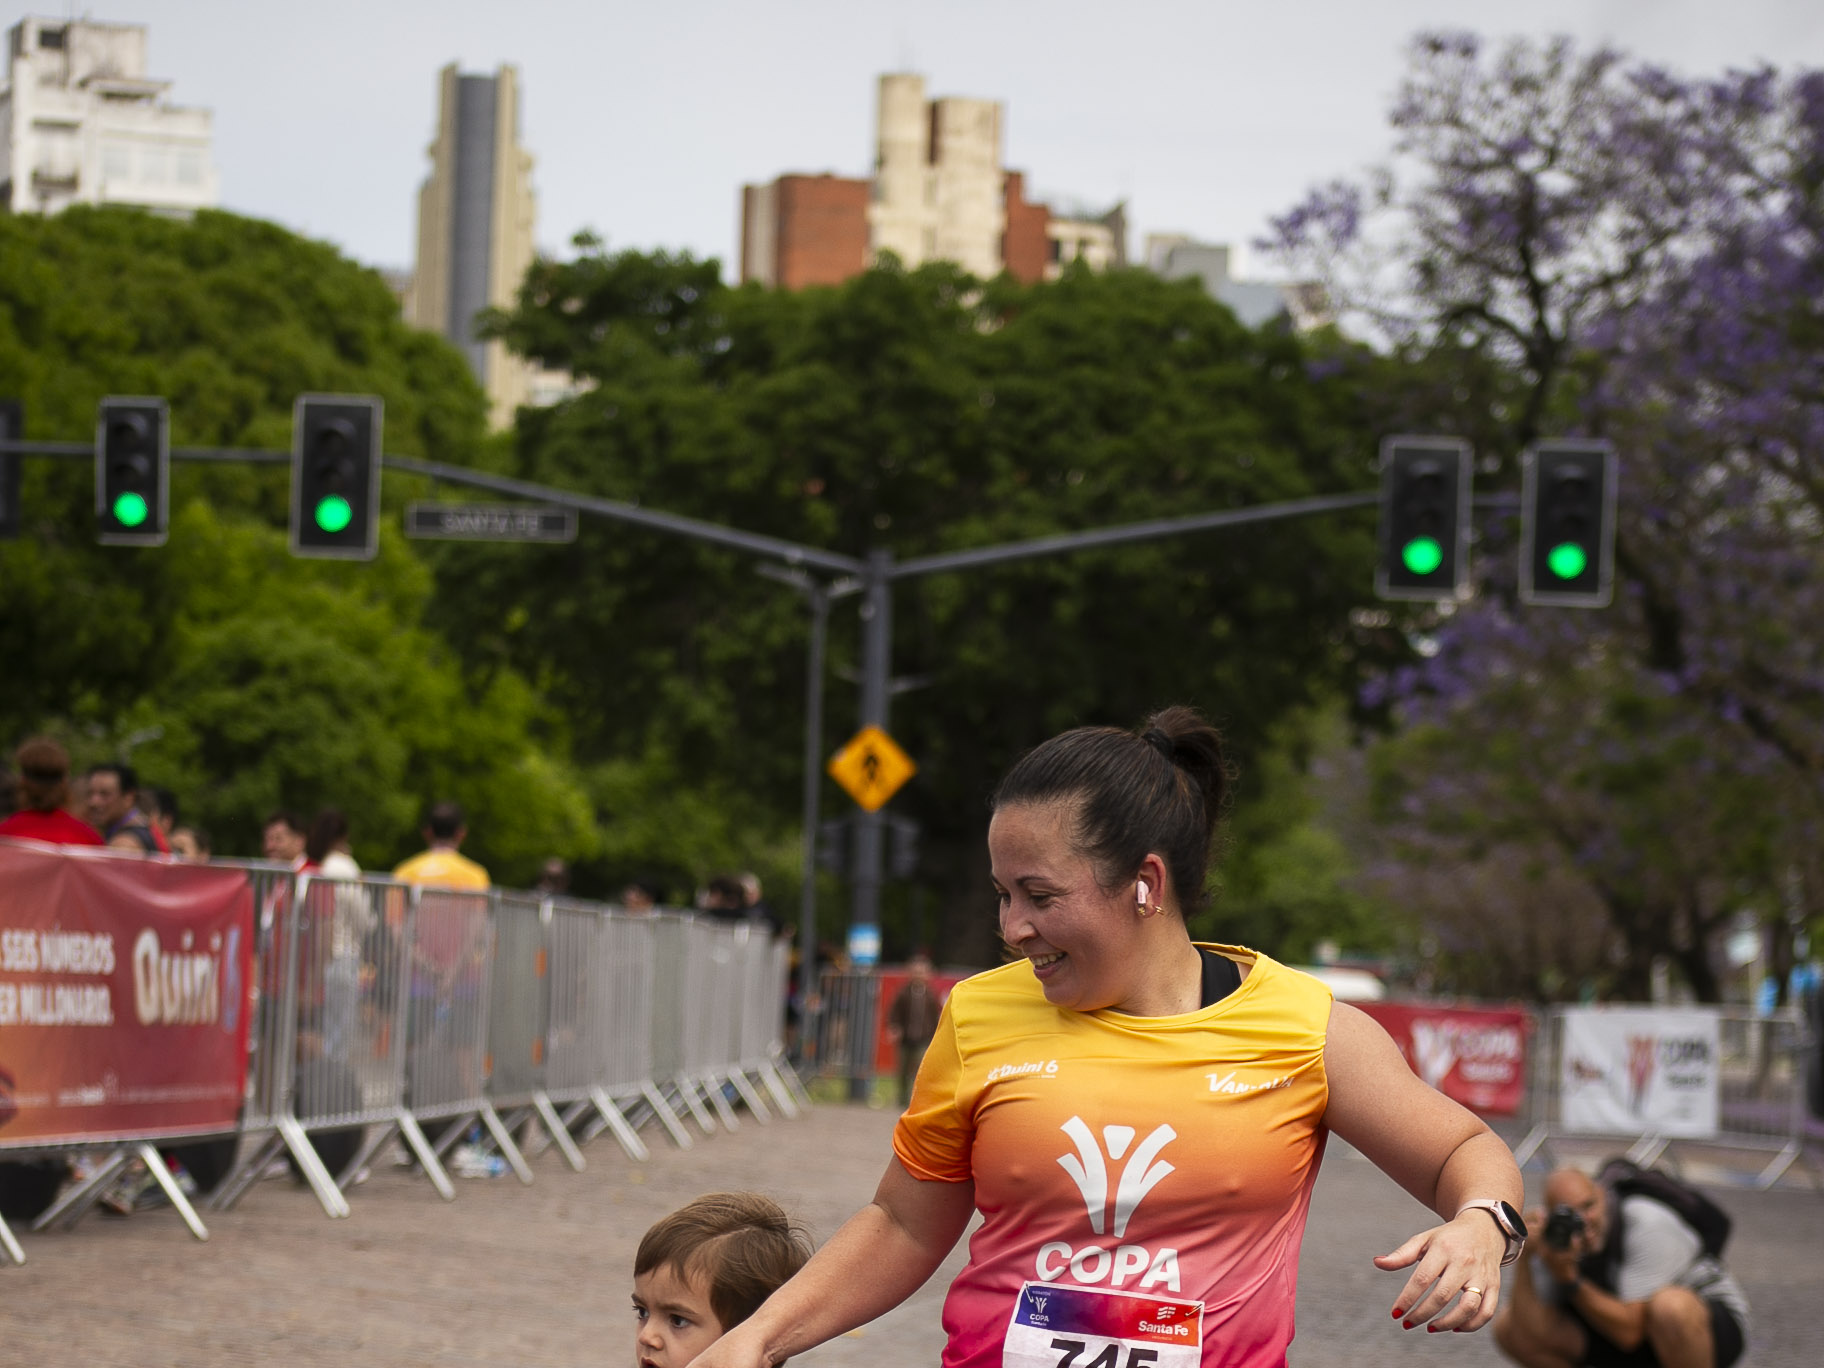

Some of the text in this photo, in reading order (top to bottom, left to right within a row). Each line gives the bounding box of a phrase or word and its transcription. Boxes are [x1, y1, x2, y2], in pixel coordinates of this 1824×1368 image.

[1046, 1060, 1059, 1074] 6
[1036, 1242, 1181, 1293] COPA
[1030, 1313, 1050, 1323] COPA
[1138, 1320, 1189, 1336] Santa Fe
